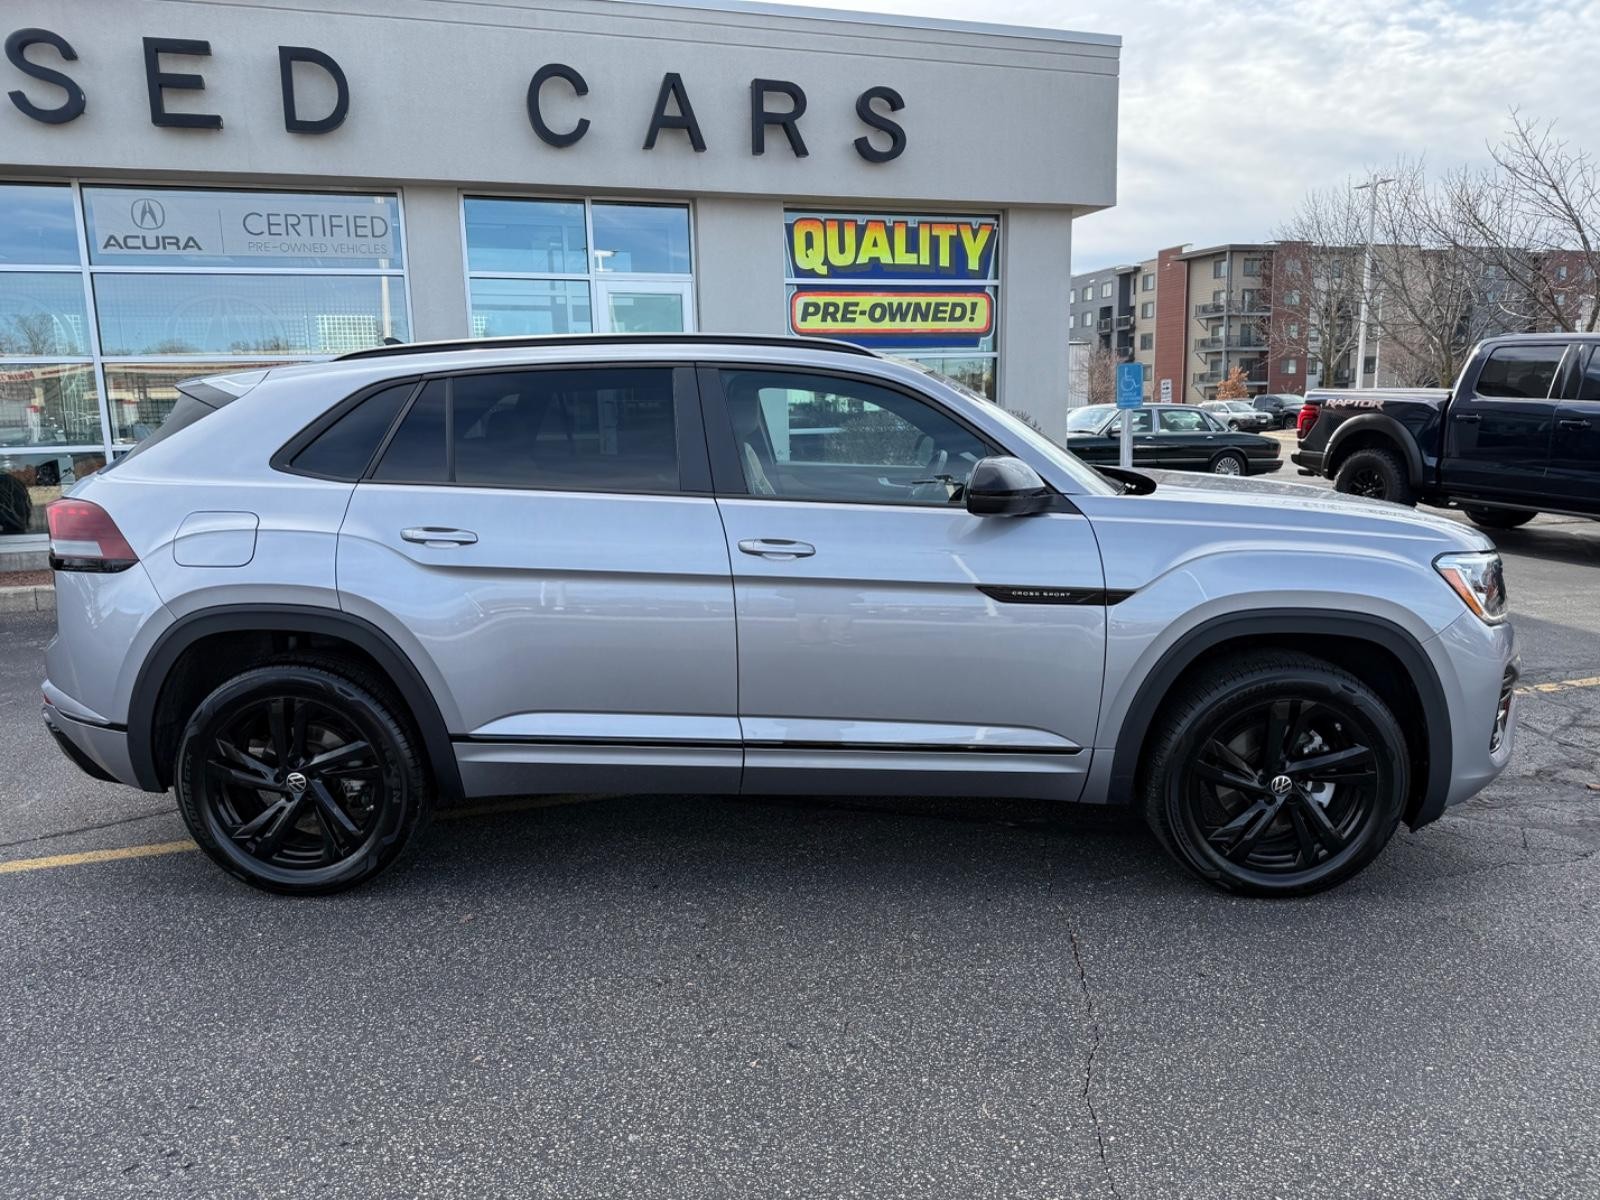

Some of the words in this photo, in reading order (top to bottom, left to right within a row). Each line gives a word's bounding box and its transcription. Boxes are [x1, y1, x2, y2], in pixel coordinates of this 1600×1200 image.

[526, 63, 908, 164] CARS
[242, 212, 389, 239] CERTIFIED
[102, 234, 203, 251] ACURA
[247, 241, 329, 254] PRE-OWNED
[331, 243, 389, 255] VEHICLES
[792, 217, 994, 276] QUALITY
[800, 301, 979, 324] PRE-OWNED!
[1325, 399, 1385, 411] RAPTOR
